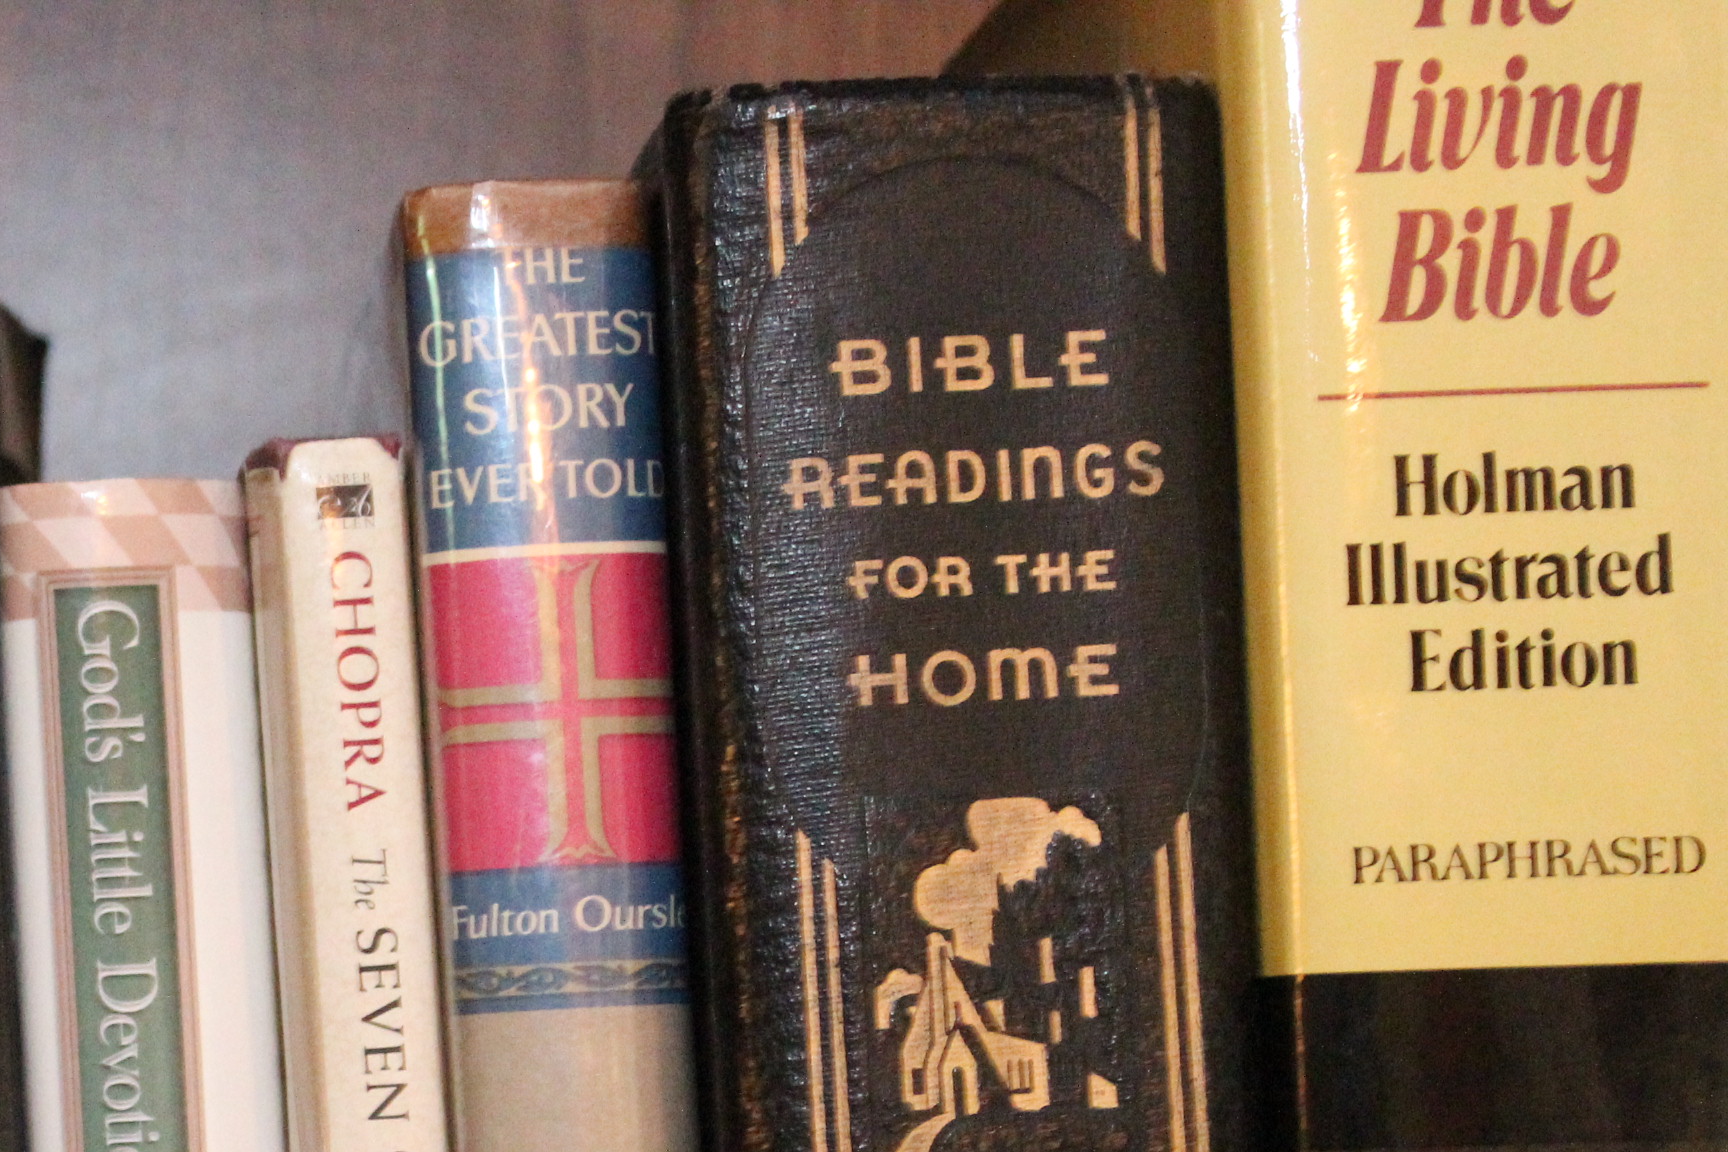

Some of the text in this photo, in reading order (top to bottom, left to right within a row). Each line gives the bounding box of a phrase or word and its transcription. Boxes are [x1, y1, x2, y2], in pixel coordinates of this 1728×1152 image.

[1355, 53, 1643, 195] Living
[496, 247, 586, 287] THE
[1377, 201, 1621, 323] Bible
[828, 328, 1110, 397] BIBLE
[462, 381, 635, 437] STORY
[429, 461, 546, 511] EVER
[782, 438, 1165, 511] READINGS
[1392, 449, 1637, 517] Holman
[846, 548, 1118, 600] FOR THE
[1344, 531, 1675, 607] Illustrated
[78, 599, 148, 763] God's
[328, 550, 388, 813] CHOPRA
[845, 642, 1120, 707] HOME
[1408, 626, 1639, 693] Edition
[85, 783, 154, 935] Little
[349, 848, 390, 911] The
[1351, 833, 1708, 885] PARAPHRASED
[452, 902, 560, 942] Fulton
[355, 926, 411, 1122] SEVEN
